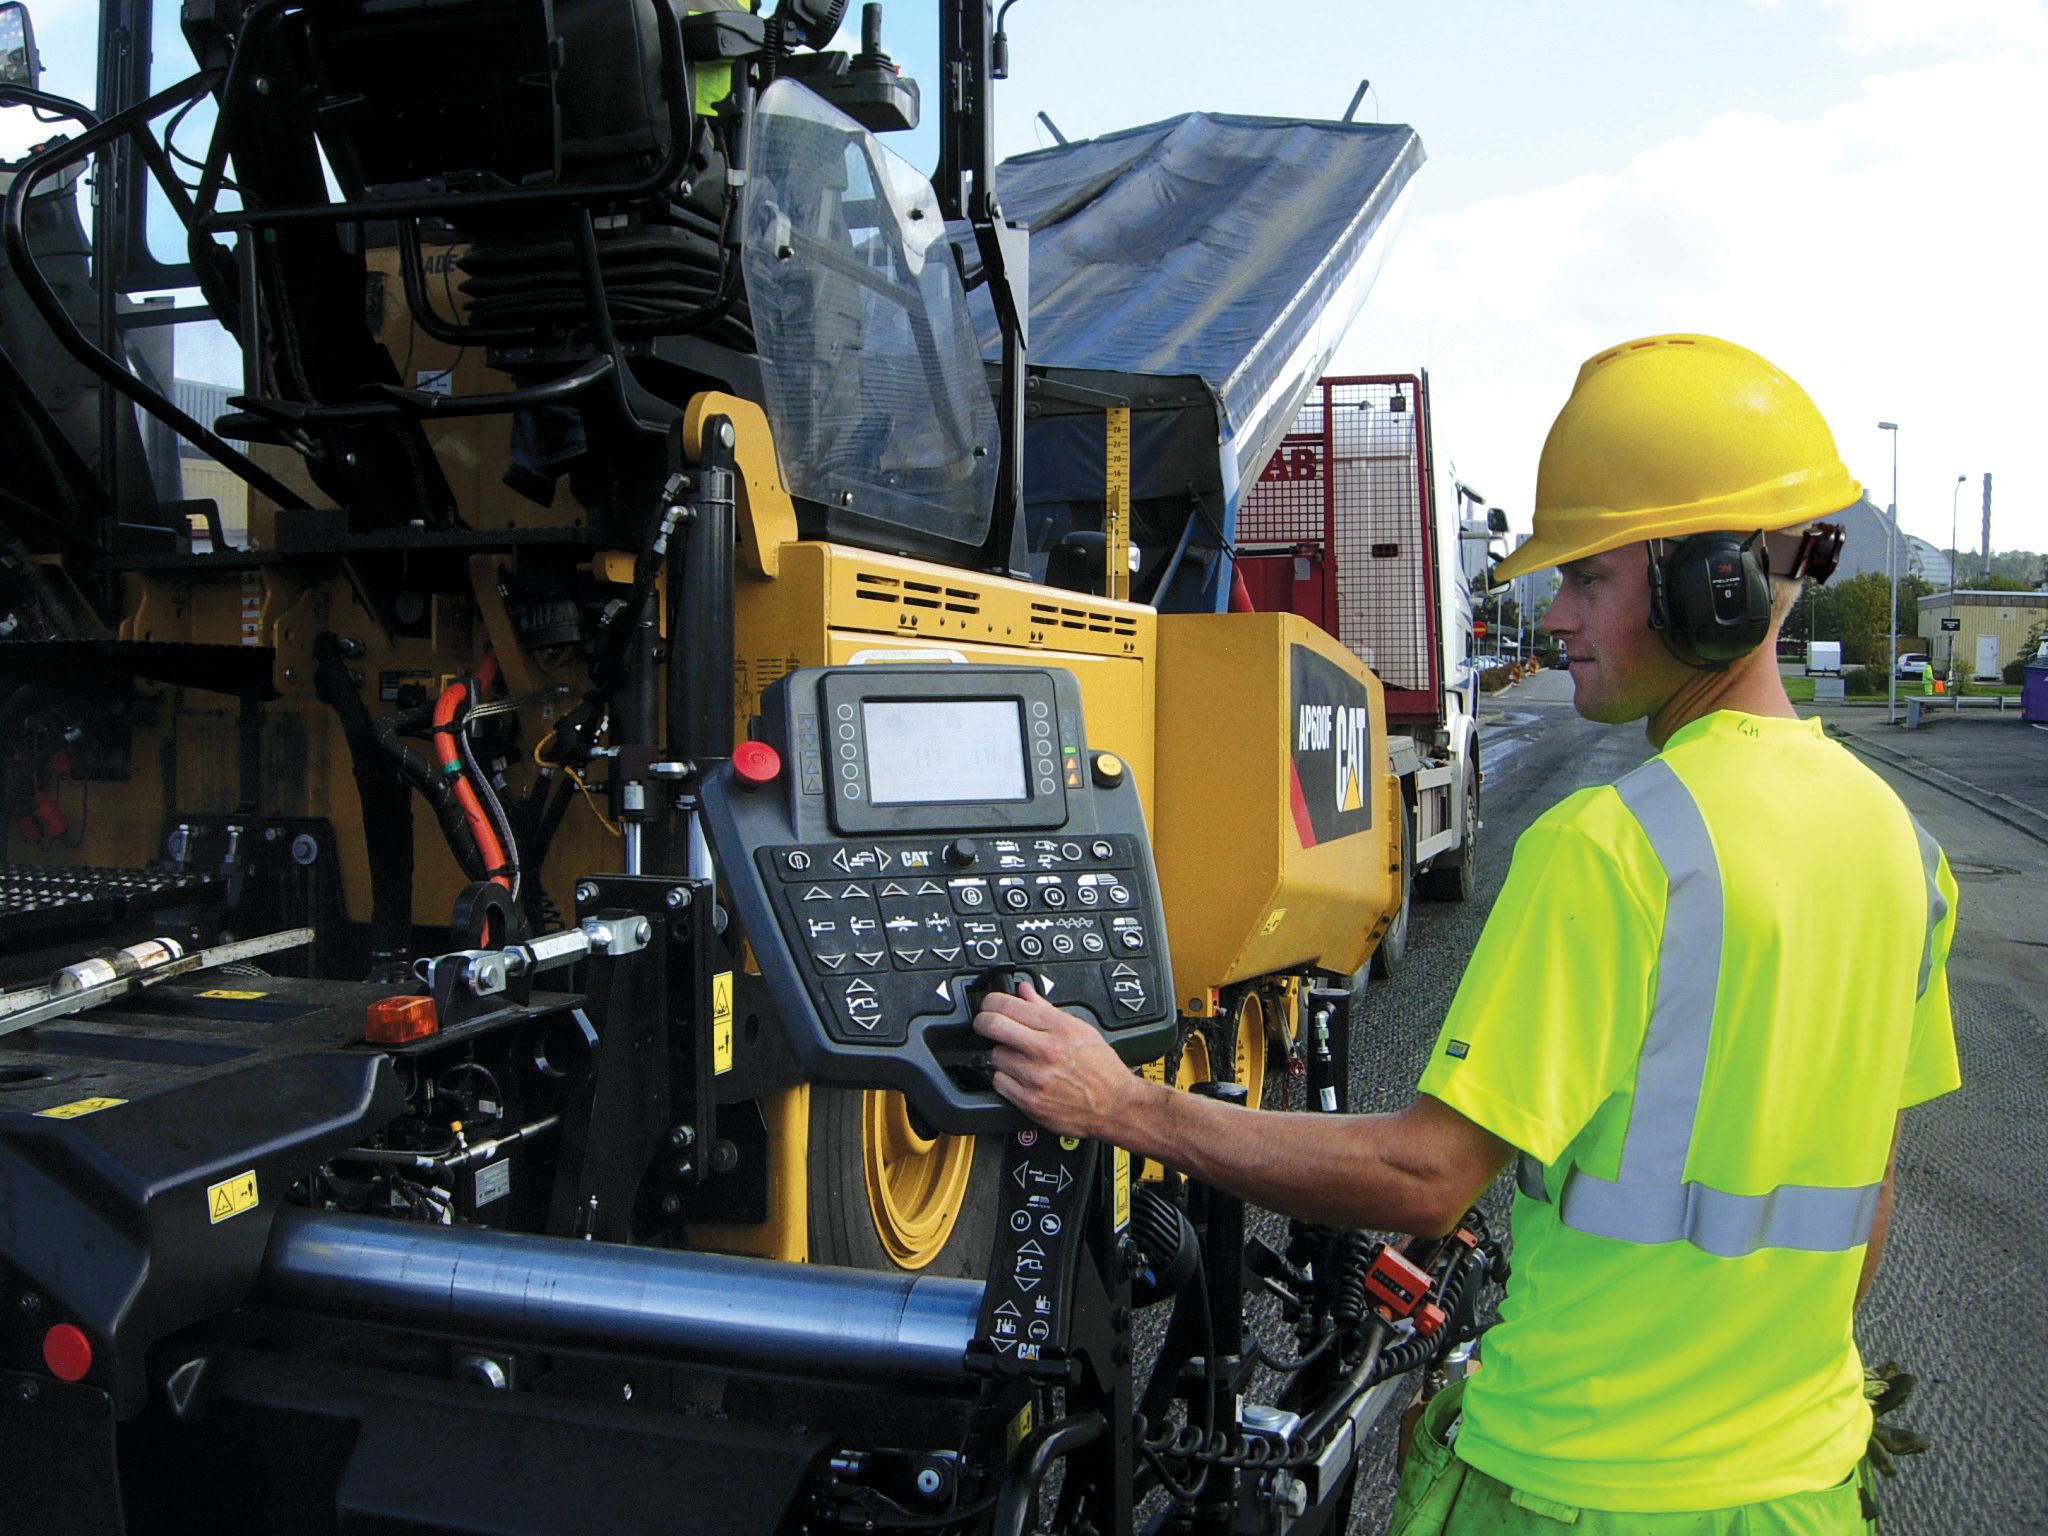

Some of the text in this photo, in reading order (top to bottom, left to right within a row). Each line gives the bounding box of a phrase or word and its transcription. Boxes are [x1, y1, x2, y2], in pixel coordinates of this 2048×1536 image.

[1298, 704, 1366, 813] AP600F CAT
[900, 850, 930, 868] CAT
[1017, 1342, 1041, 1361] CAT
